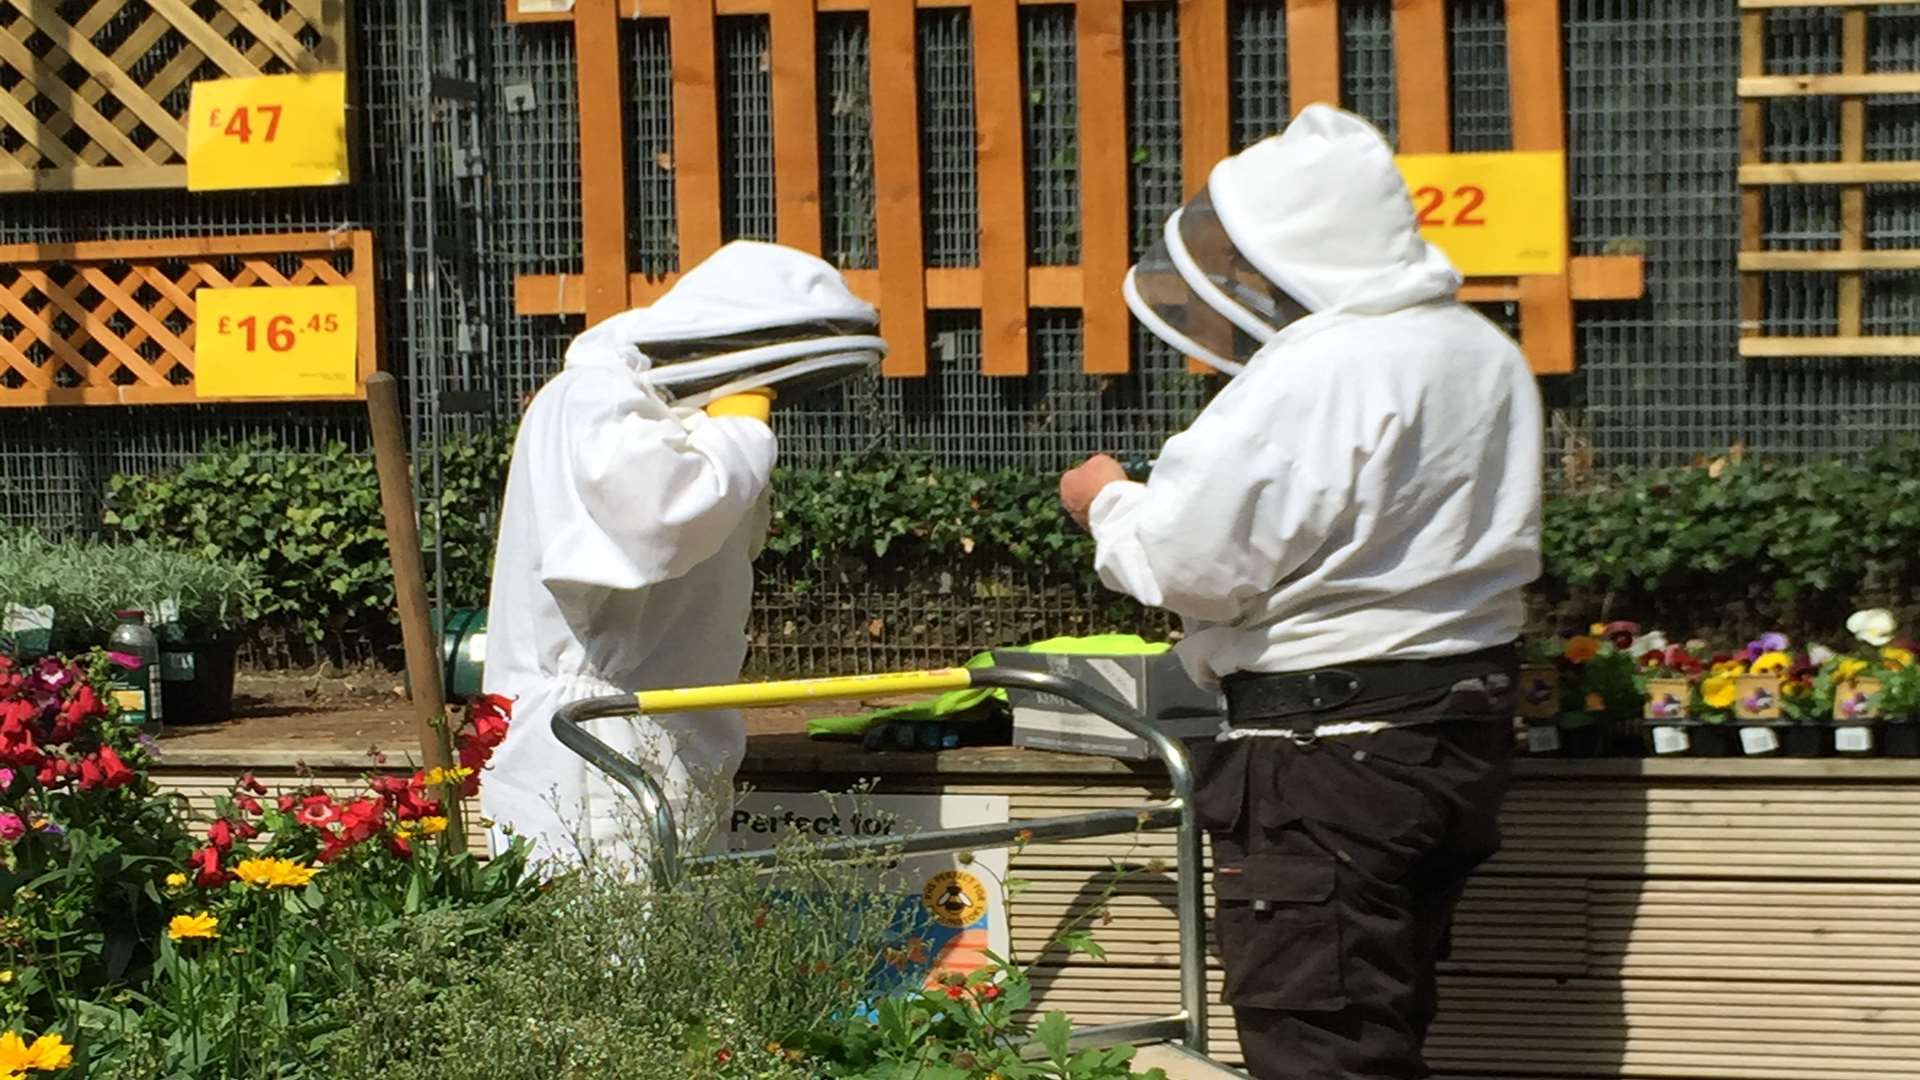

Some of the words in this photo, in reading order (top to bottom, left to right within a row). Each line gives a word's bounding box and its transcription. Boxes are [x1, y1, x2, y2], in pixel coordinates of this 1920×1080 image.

[209, 106, 283, 144] £47
[218, 313, 339, 352] £16.45
[731, 810, 842, 835] Perfect
[850, 813, 895, 835] for
